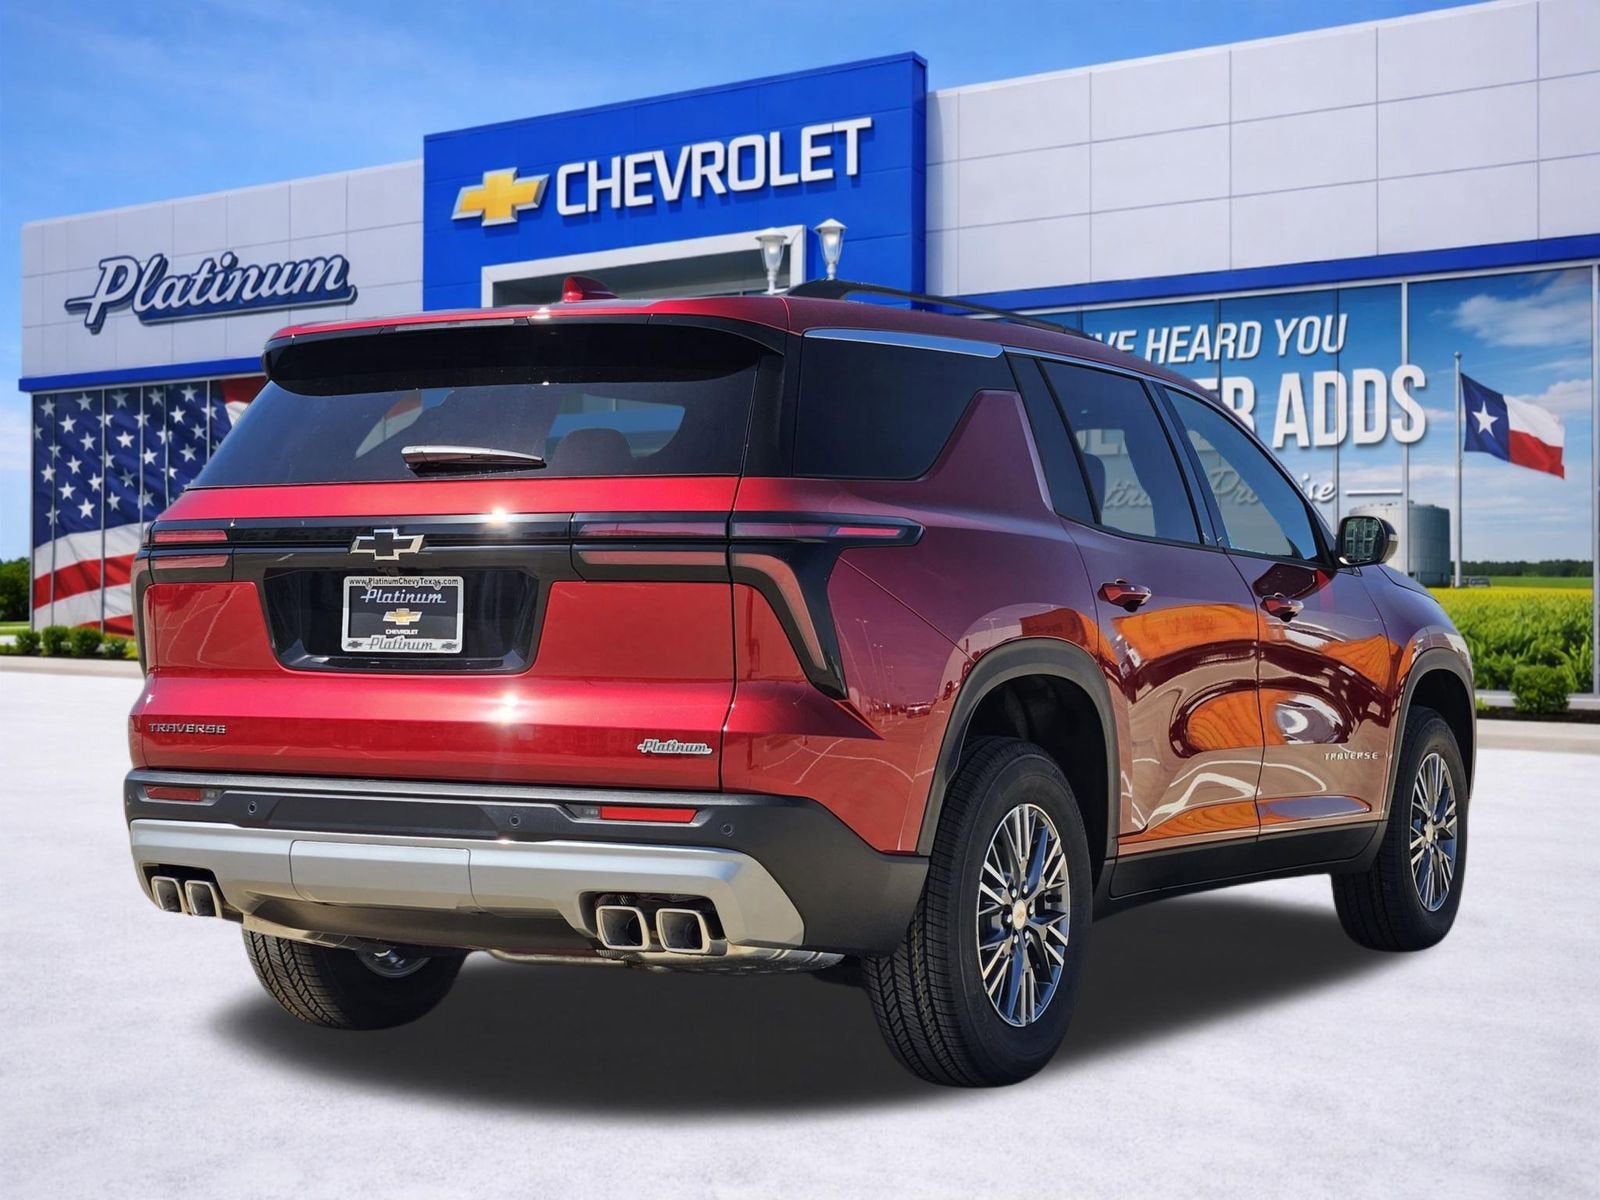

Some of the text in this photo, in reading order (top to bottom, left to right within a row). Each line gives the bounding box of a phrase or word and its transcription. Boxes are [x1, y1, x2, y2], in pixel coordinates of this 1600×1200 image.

[556, 117, 873, 216] CHEVROLET
[65, 251, 356, 332] Platinum
[1144, 320, 1263, 365] HEARD
[1273, 313, 1348, 357] YOU
[1271, 364, 1427, 449] ADDS
[360, 588, 447, 604] Platinum
[367, 637, 437, 650] Platinum
[148, 723, 226, 734] TRAVERSE
[636, 738, 713, 754] Platinum
[1324, 752, 1378, 760] TRAVERSE
